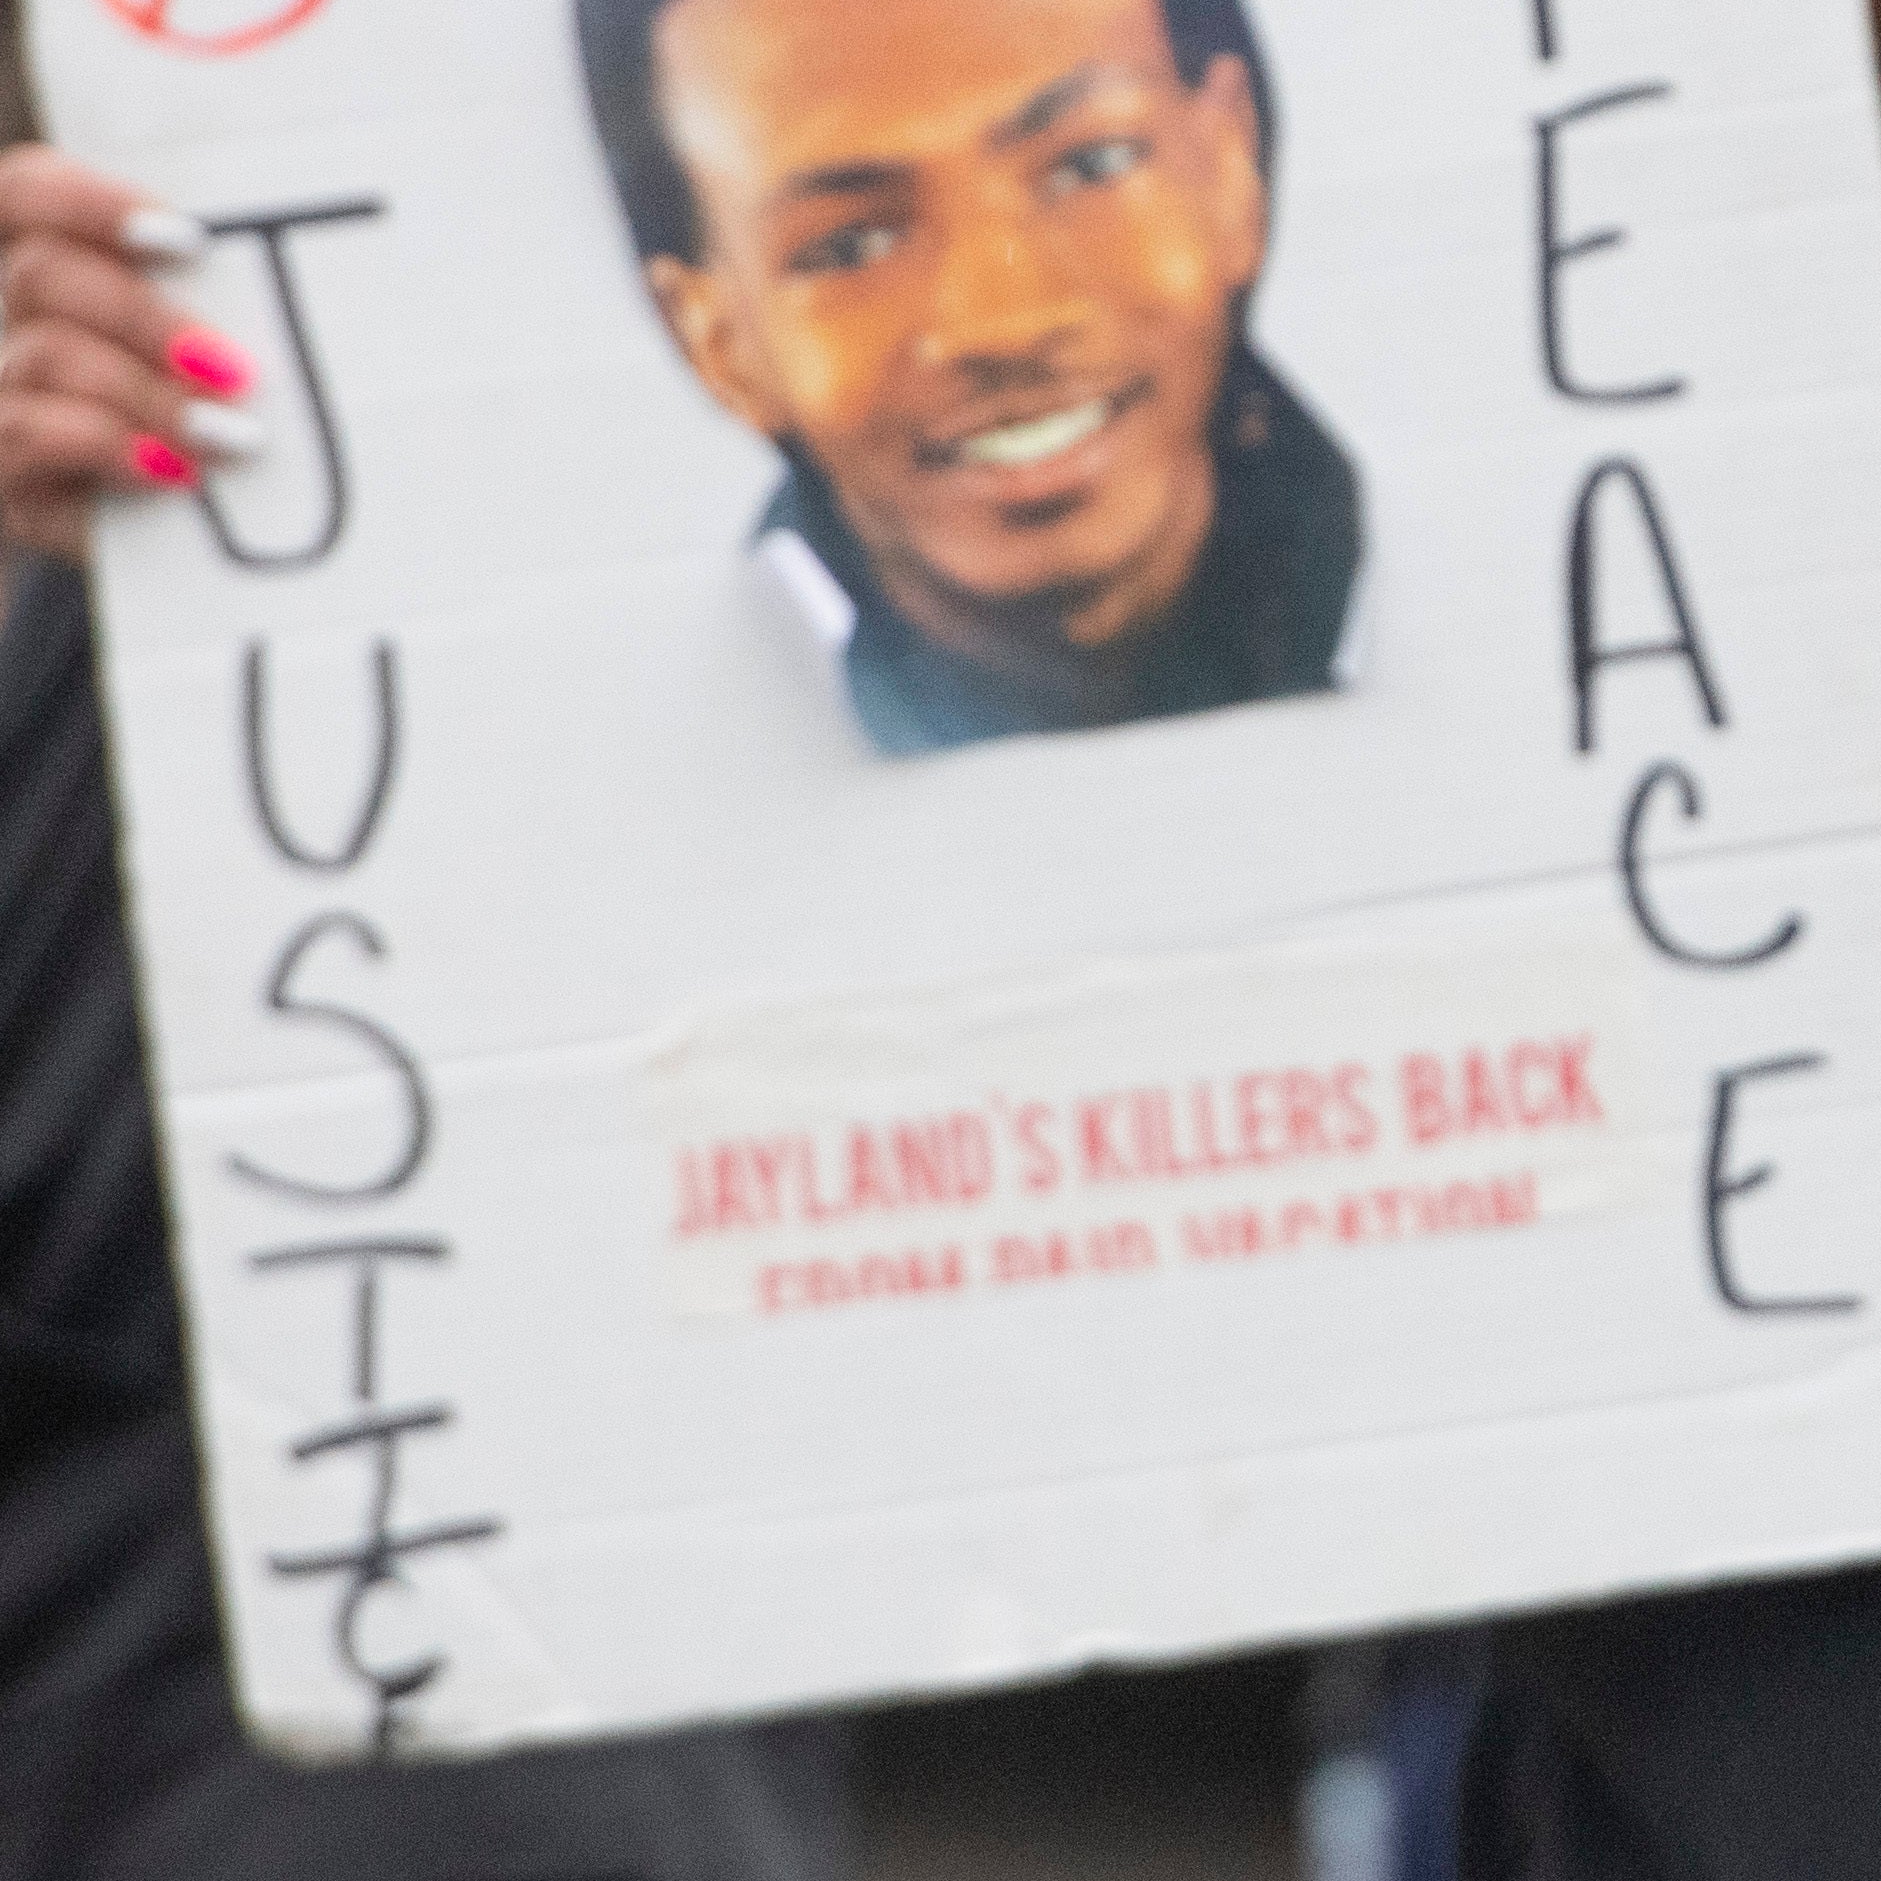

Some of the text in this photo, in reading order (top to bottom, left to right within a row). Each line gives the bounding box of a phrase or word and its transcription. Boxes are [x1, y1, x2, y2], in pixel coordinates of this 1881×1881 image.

[673, 1029, 1606, 1244] JAYLAND'S KILLERS BACK
